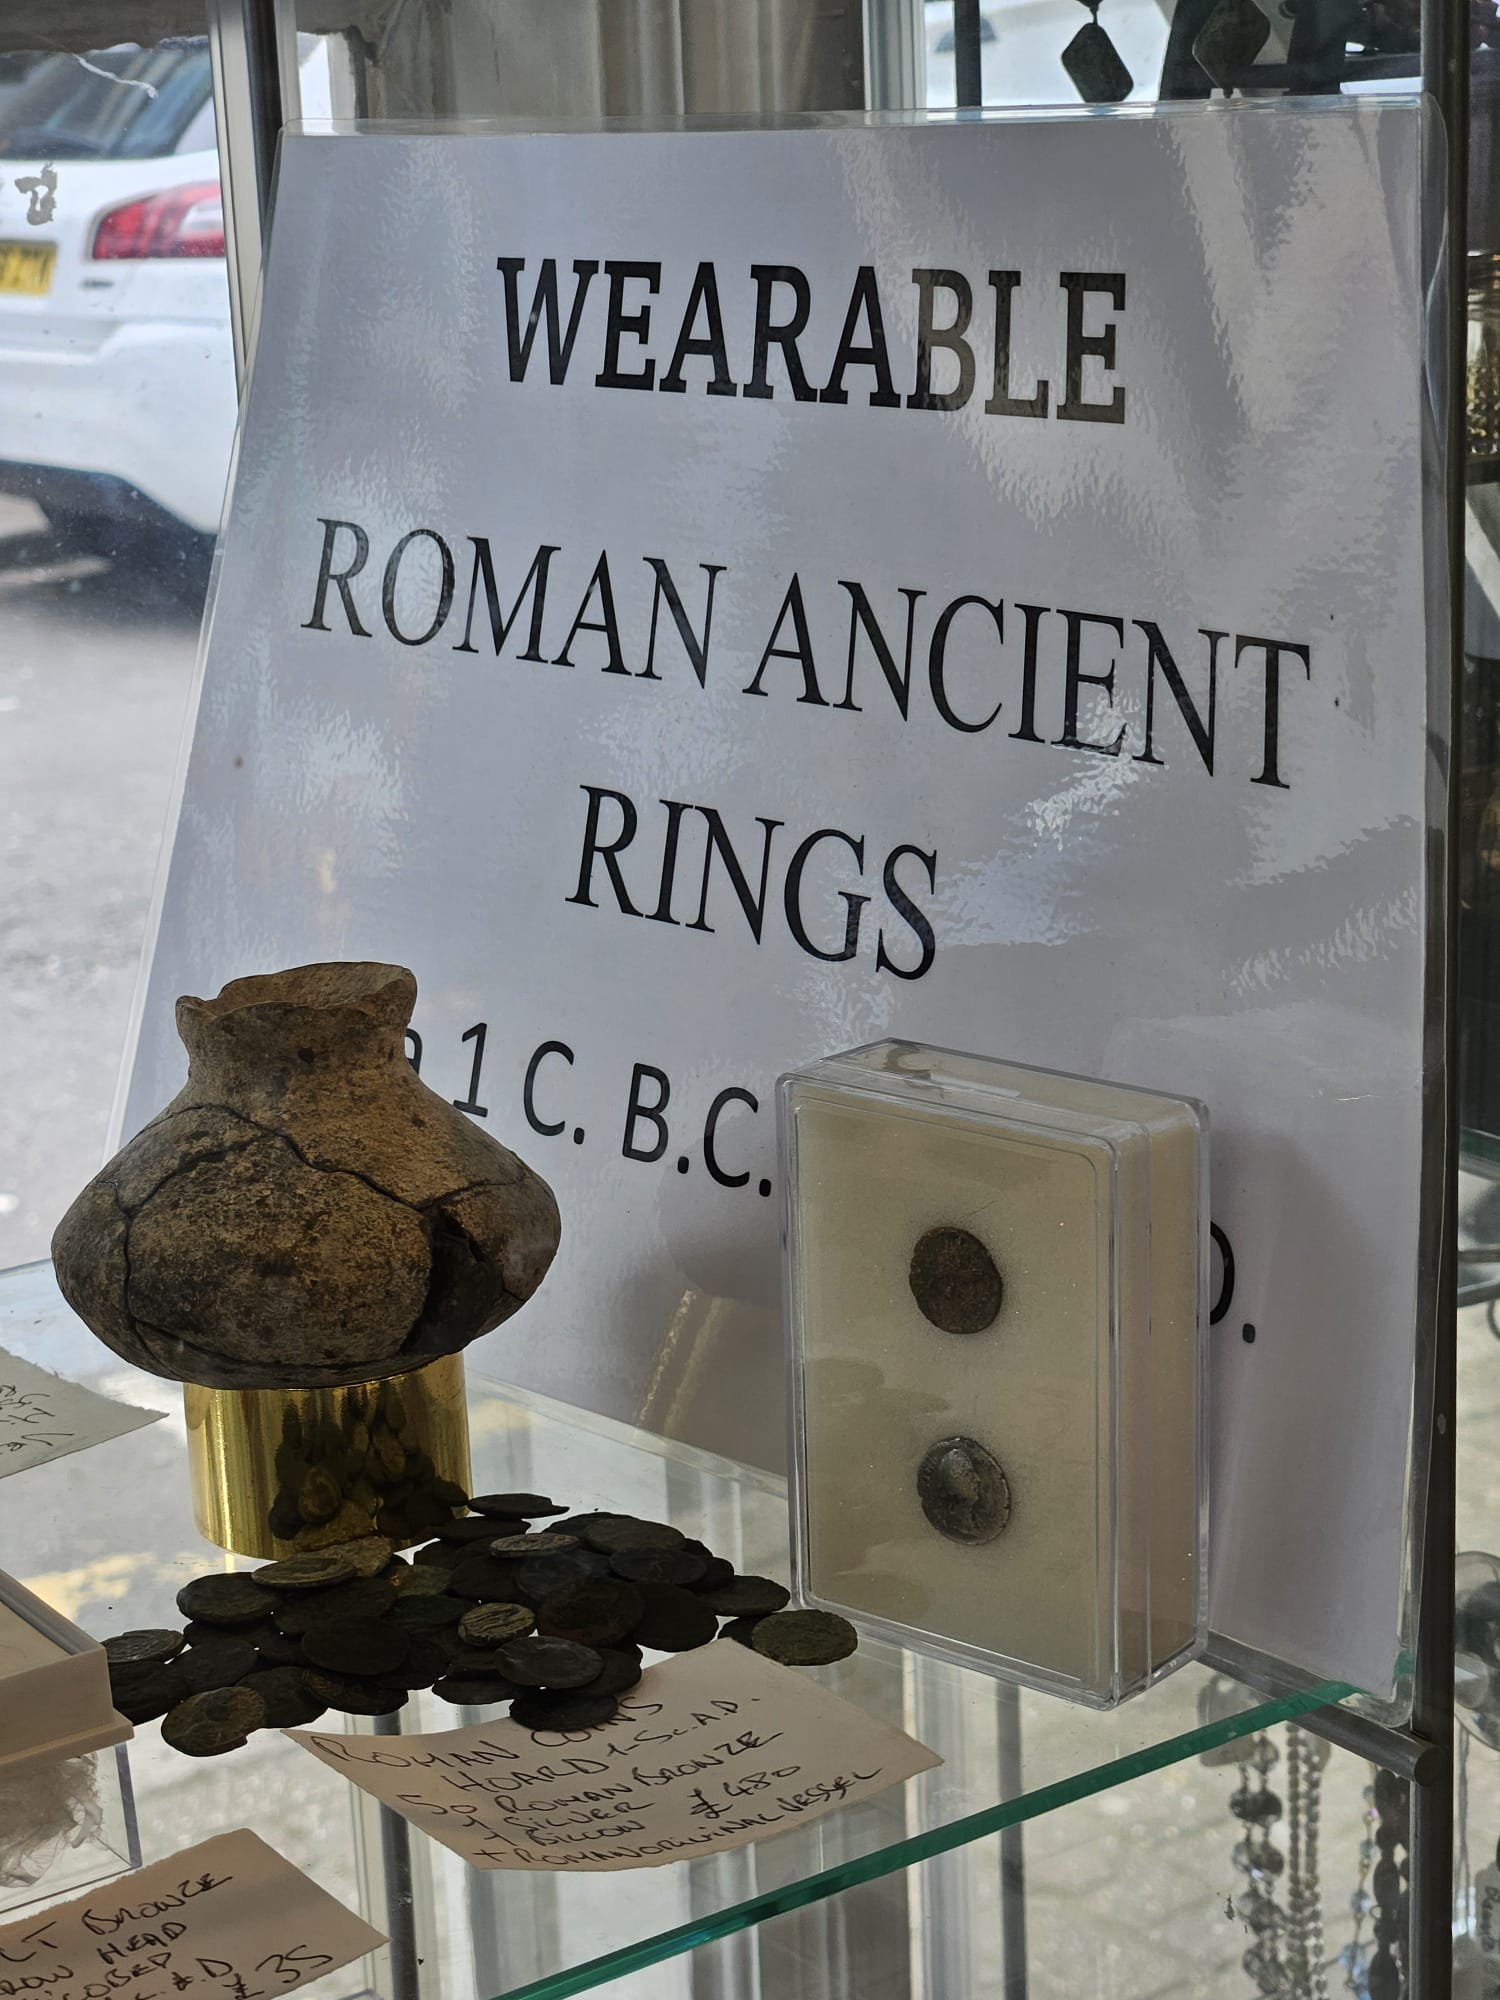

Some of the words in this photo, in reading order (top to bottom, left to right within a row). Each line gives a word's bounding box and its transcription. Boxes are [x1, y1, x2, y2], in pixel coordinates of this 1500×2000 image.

[496, 257, 1127, 425] WEARABLE
[300, 517, 728, 690] ROMAN
[742, 571, 1311, 789] ANCIENT
[565, 784, 938, 981] RINGS
[622, 1063, 772, 1197] B.C.
[310, 1736, 520, 1768] ROMAN
[441, 1758, 609, 1793] HOARD
[494, 1783, 633, 1814] ROMAN
[632, 1731, 784, 1787] BRONZE
[688, 1766, 801, 1819] £480
[81, 1873, 233, 1936] BRONZE
[97, 1922, 187, 1965] HEAD
